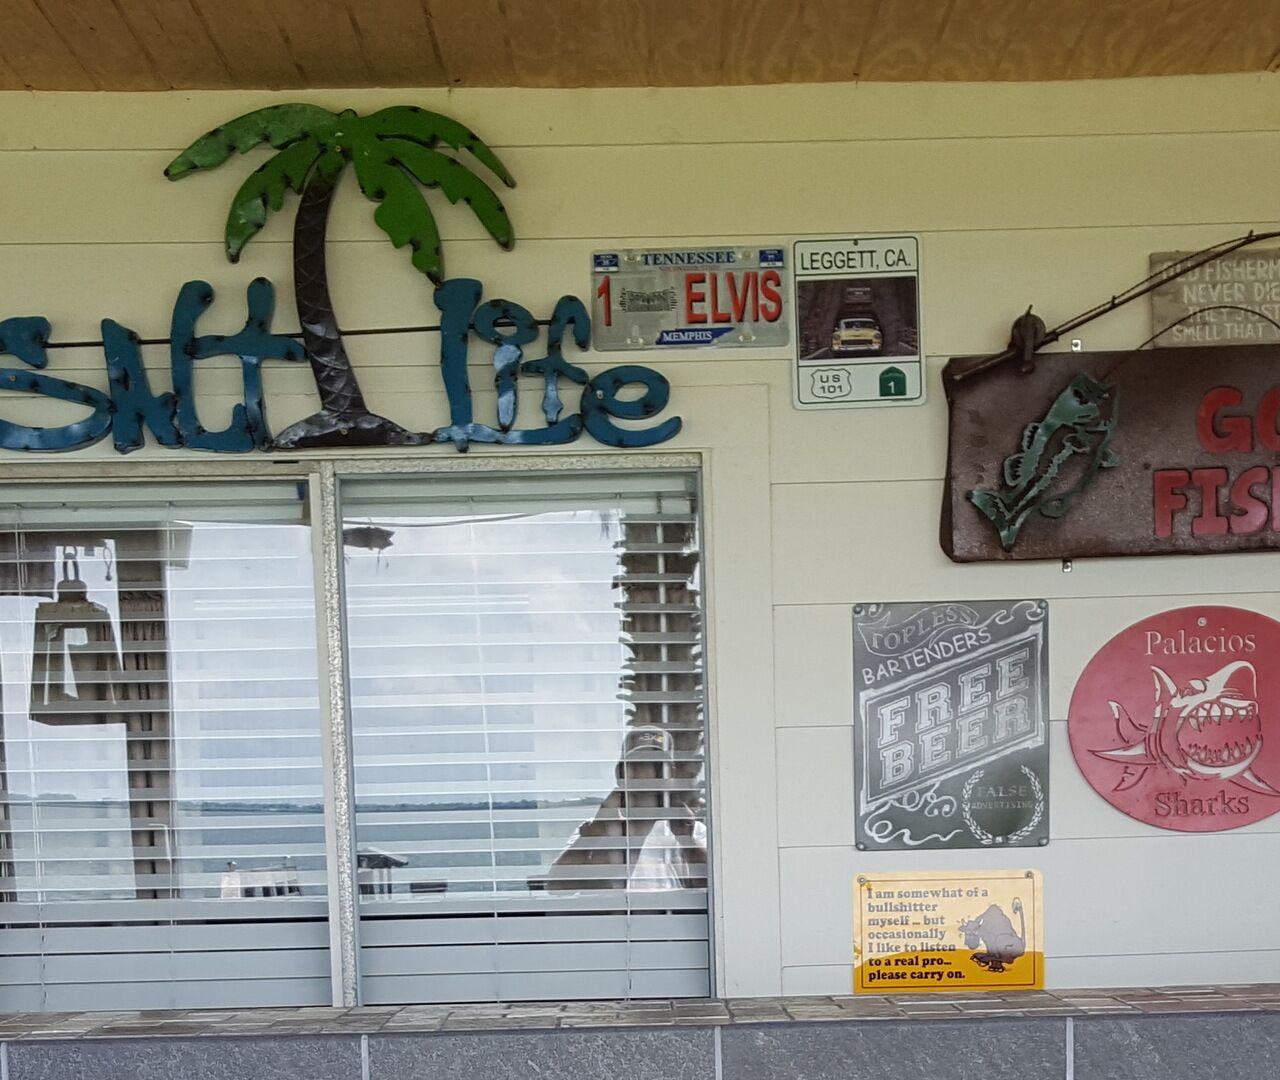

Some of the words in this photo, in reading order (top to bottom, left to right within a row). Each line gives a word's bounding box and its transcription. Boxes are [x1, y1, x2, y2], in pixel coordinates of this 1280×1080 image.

[641, 251, 736, 266] TENNESSEE
[801, 250, 880, 271] LEGGETT,
[884, 249, 912, 267] CA.
[597, 274, 612, 327] 1
[685, 269, 783, 325] ELVIS
[1183, 283, 1246, 303] NEVER
[1188, 306, 1232, 323] THEY
[662, 331, 713, 341] MEMPHIS
[1172, 323, 1220, 342] SMELL
[1224, 322, 1266, 340] THAT
[820, 374, 841, 384] US
[820, 385, 842, 394] 101
[888, 381, 895, 394] 1
[871, 606, 972, 650] TOPLESS
[1144, 628, 1256, 655] Palacios
[862, 627, 992, 685] BARTENDERS
[877, 648, 1030, 749] FREE
[880, 695, 1030, 789] BEER
[978, 785, 1028, 797] FALSE
[971, 800, 1034, 809] ADVERTISING
[1154, 790, 1250, 818] Sharks
[867, 888, 873, 899] I
[875, 890, 895, 899] am
[897, 887, 963, 899] somewhat
[966, 886, 980, 898] of
[981, 889, 989, 897] a
[868, 902, 939, 913] bullshitter
[868, 916, 910, 928] myself
[923, 916, 945, 926] but
[868, 929, 946, 941] occasionally
[868, 943, 873, 953] I
[877, 941, 901, 953] like
[904, 942, 917, 953] to
[920, 941, 956, 953] listen
[869, 956, 882, 967] to
[884, 958, 892, 967] a
[894, 955, 920, 967] real
[868, 970, 907, 983] please
[911, 970, 947, 983] carry
[948, 970, 966, 980] on.
